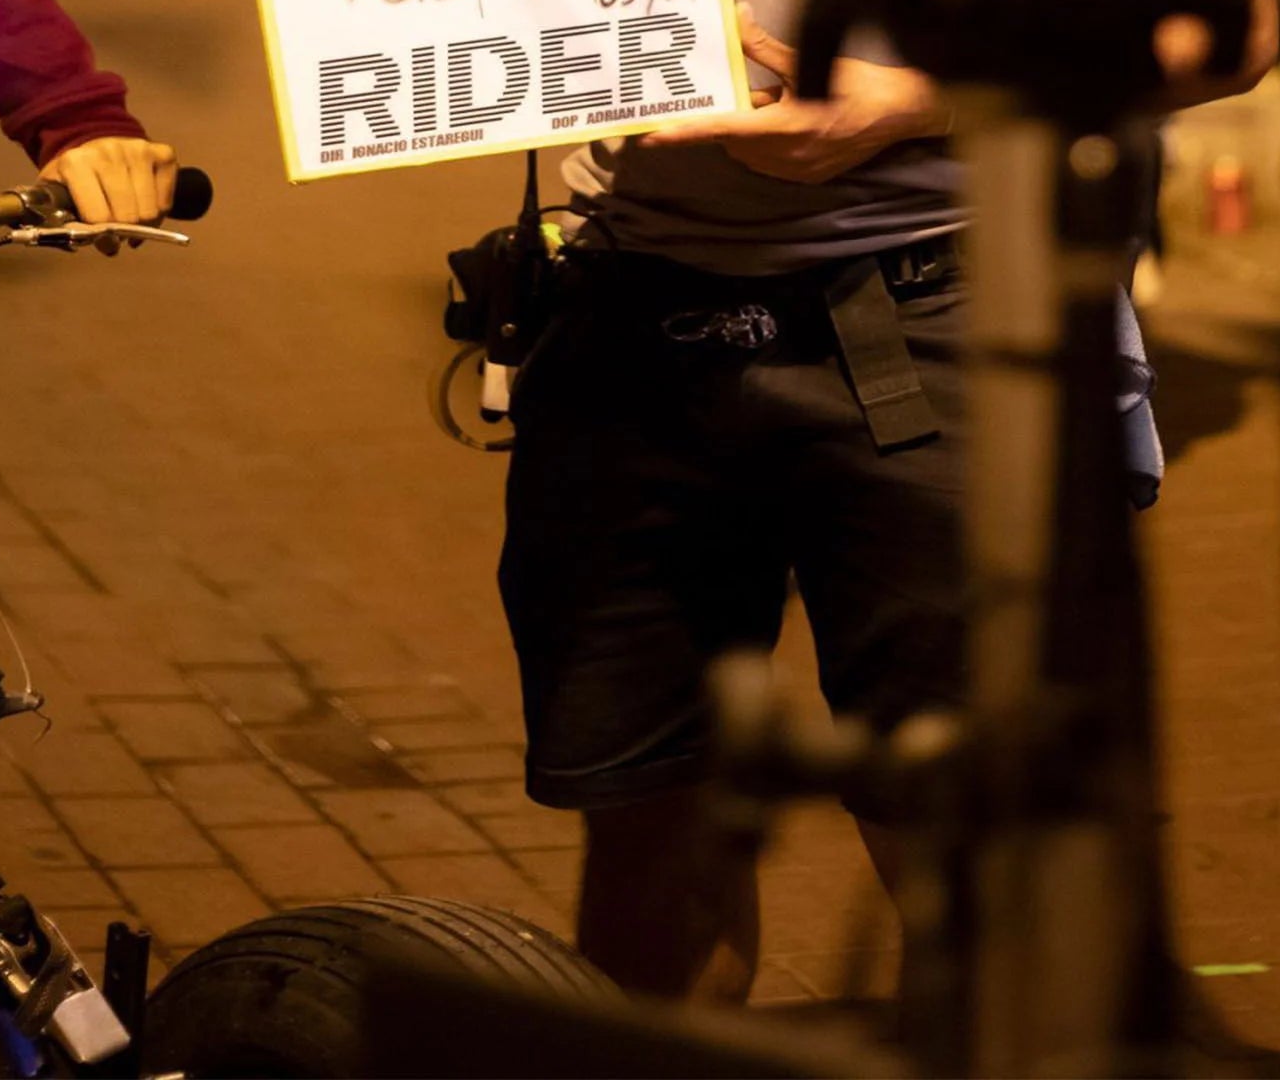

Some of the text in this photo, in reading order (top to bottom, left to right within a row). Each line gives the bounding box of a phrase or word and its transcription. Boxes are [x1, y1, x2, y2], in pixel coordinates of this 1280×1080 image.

[319, 12, 697, 147] RIDER
[551, 95, 715, 130] DOP ADRIAN BARCELONA
[320, 128, 484, 164] DIR IGNACIO ESTAREGUI
